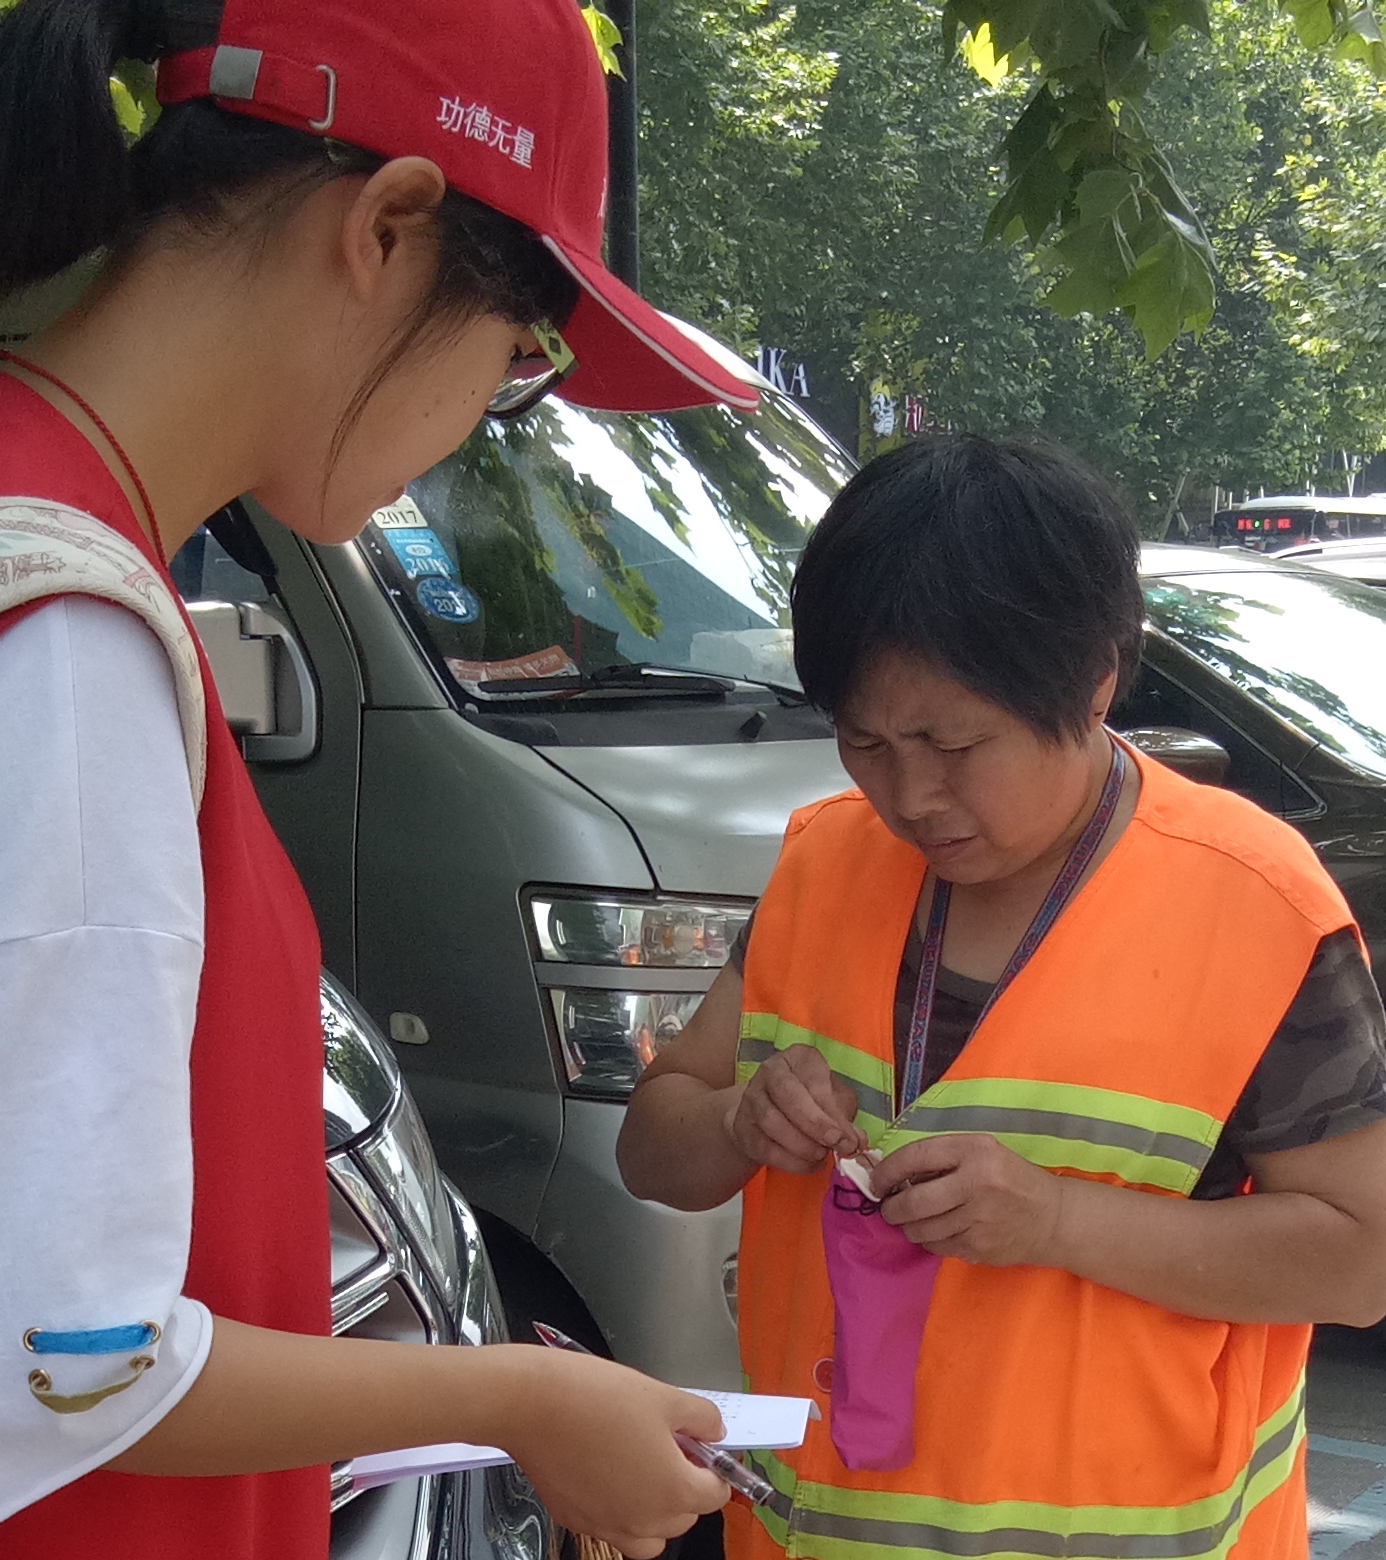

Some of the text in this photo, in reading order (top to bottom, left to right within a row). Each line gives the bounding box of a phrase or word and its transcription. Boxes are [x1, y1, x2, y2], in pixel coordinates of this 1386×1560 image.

[436, 96, 535, 170] 功德无量
[377, 510, 419, 525] 2017
